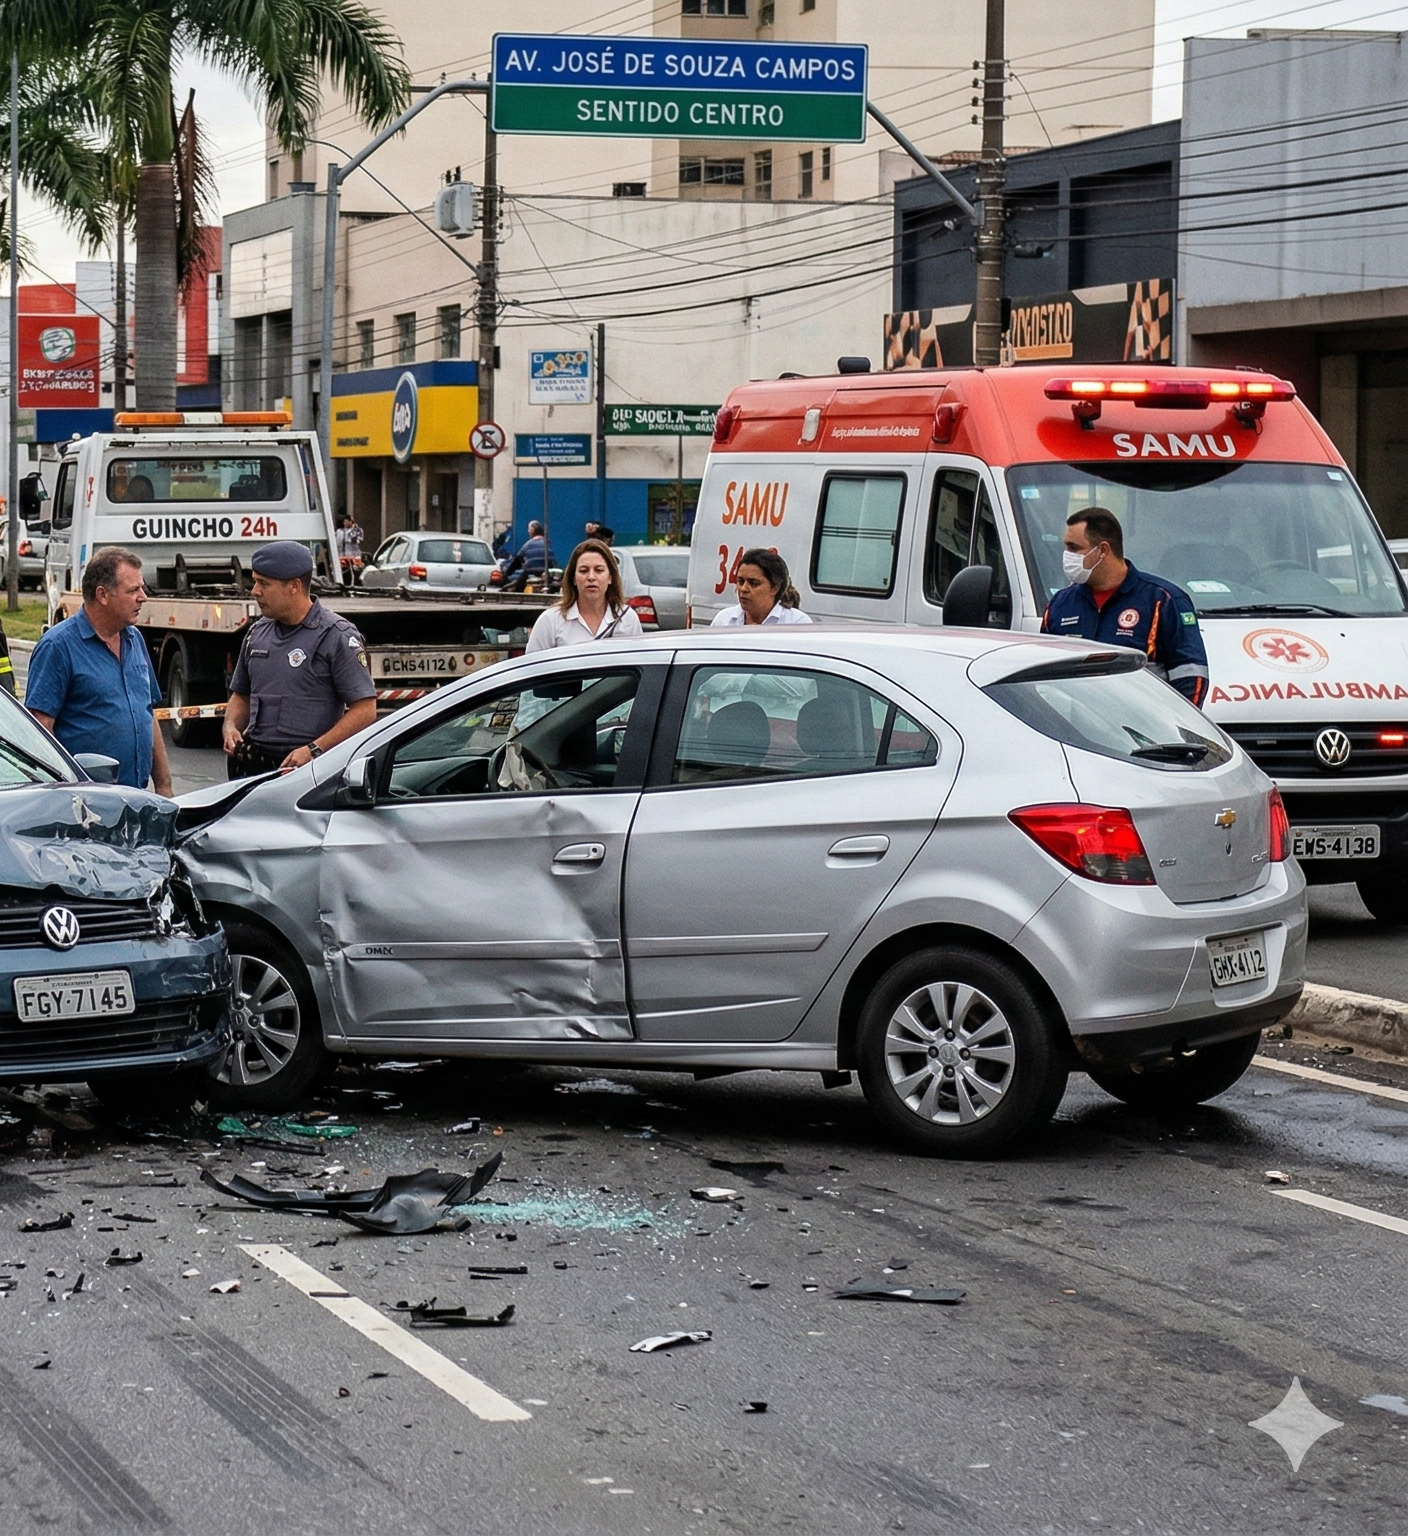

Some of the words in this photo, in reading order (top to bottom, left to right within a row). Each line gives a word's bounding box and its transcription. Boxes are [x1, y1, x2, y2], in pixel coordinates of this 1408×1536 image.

[505, 50, 541, 72] AV.
[552, 47, 615, 74] JOSÉ
[624, 54, 655, 75] DE
[664, 54, 746, 78] SOUZA
[755, 57, 856, 81] CAMPOS
[577, 99, 680, 124] SENTIDO
[689, 103, 784, 127] CENTRO
[1113, 433, 1237, 458] SAMU
[722, 481, 789, 527] SAMU
[133, 517, 234, 539] GUINCHO
[241, 516, 278, 537] 24h
[1293, 837, 1375, 856] EWS-4138
